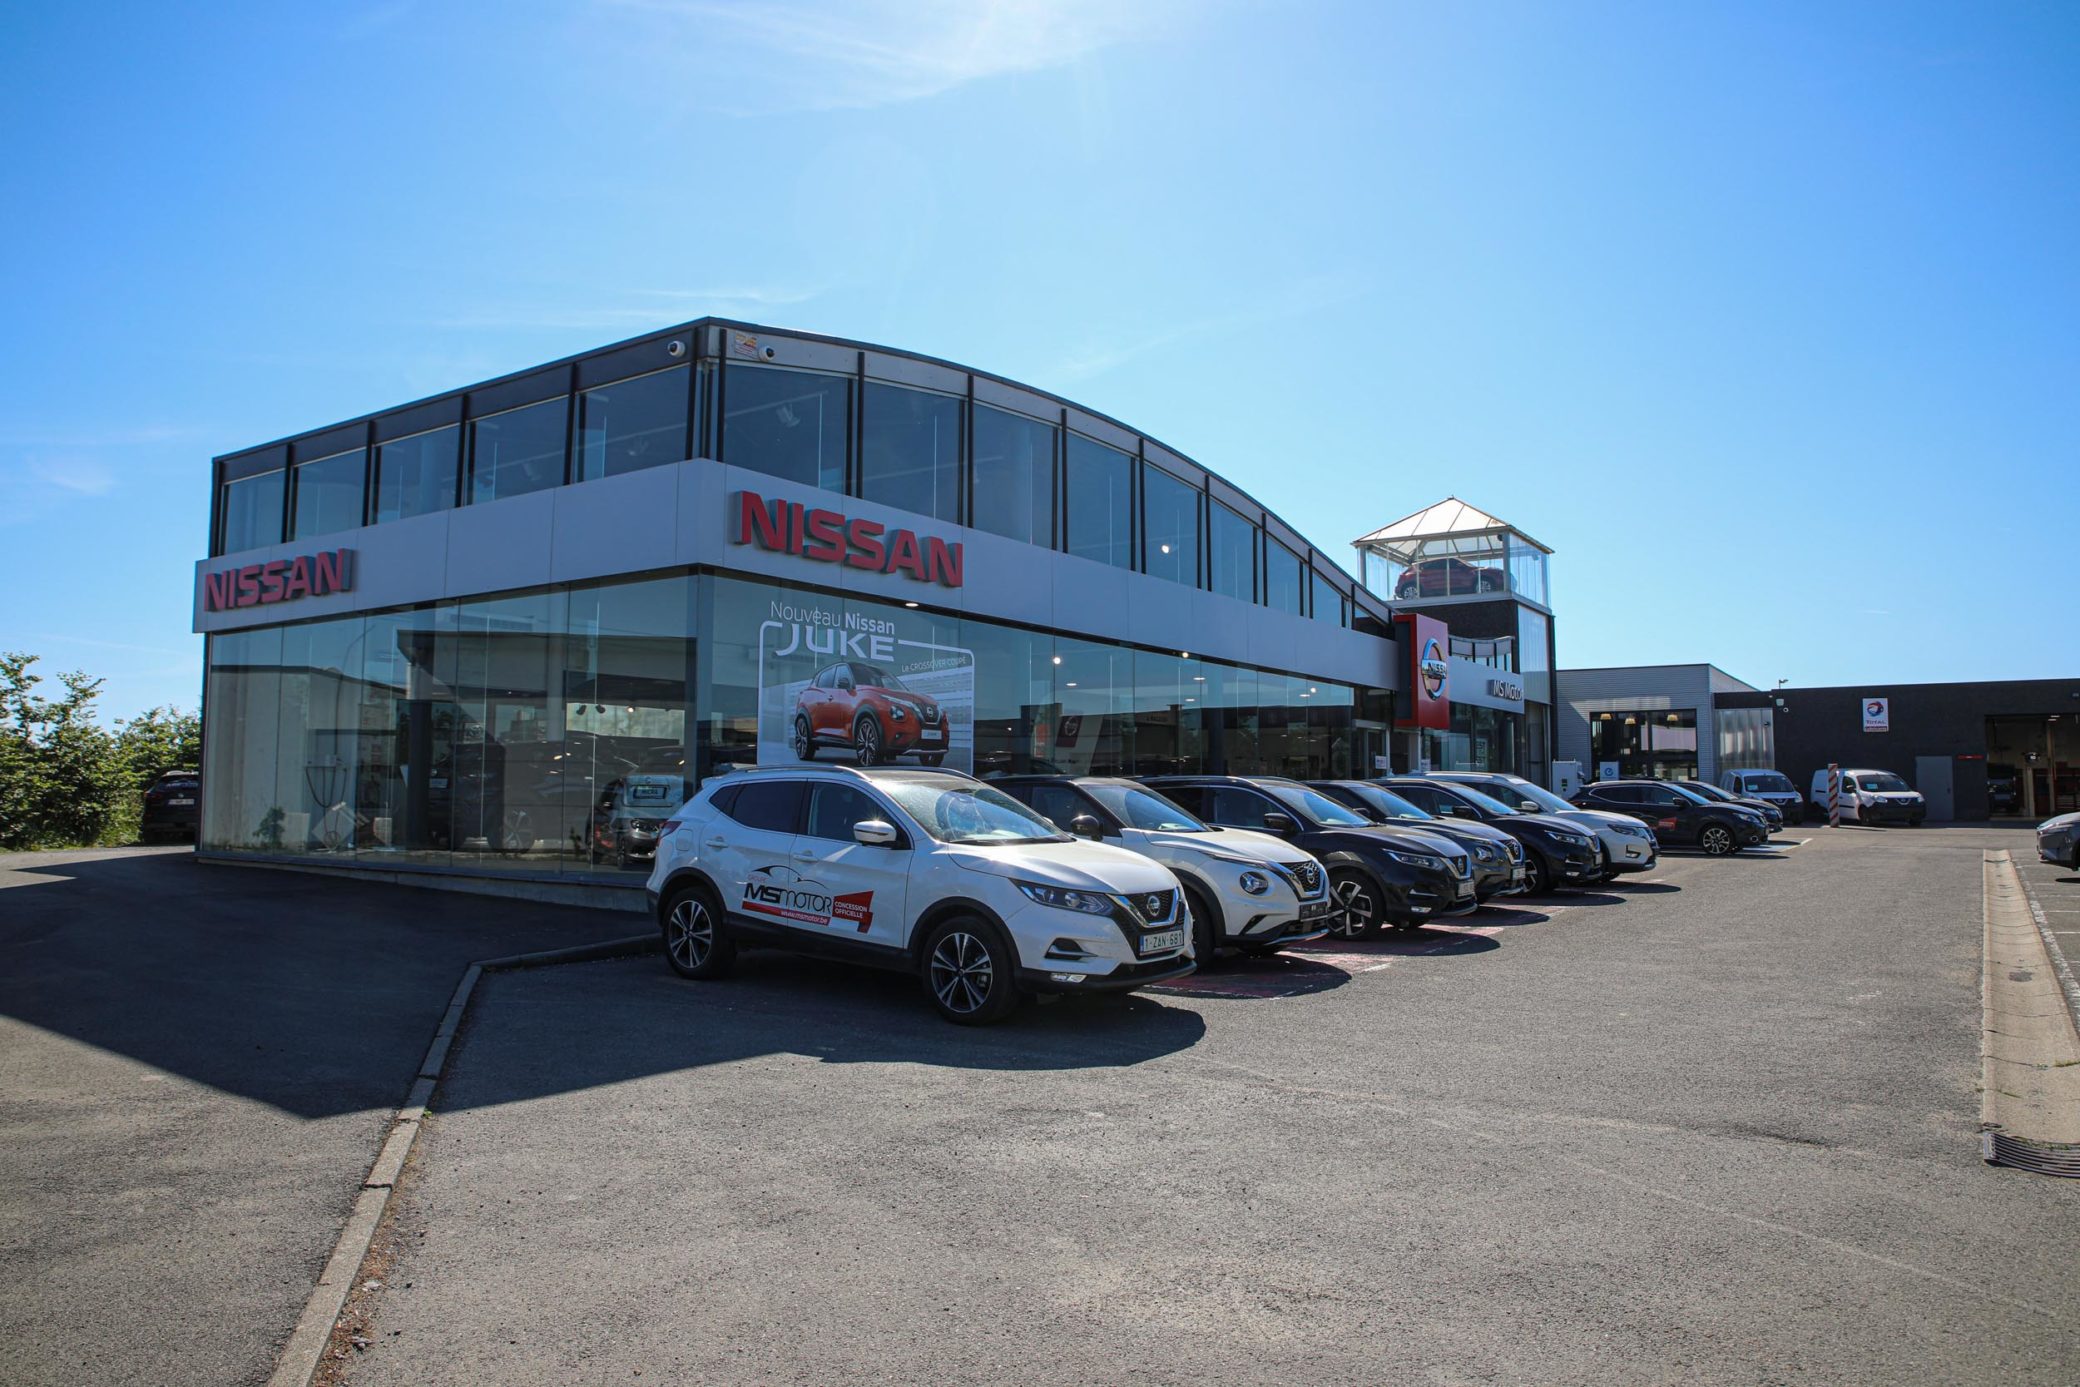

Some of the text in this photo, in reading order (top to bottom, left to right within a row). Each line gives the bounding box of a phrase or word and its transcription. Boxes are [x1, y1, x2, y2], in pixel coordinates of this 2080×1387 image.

[740, 490, 964, 588] NISSAN
[204, 548, 348, 612] NISSAN
[770, 601, 895, 635] Nouveau Nissan
[775, 624, 895, 662] JUKE
[781, 910, 828, 924] www.msmotor.be
[834, 901, 868, 913] CONCESSION
[834, 908, 863, 919] OFFICIELLE
